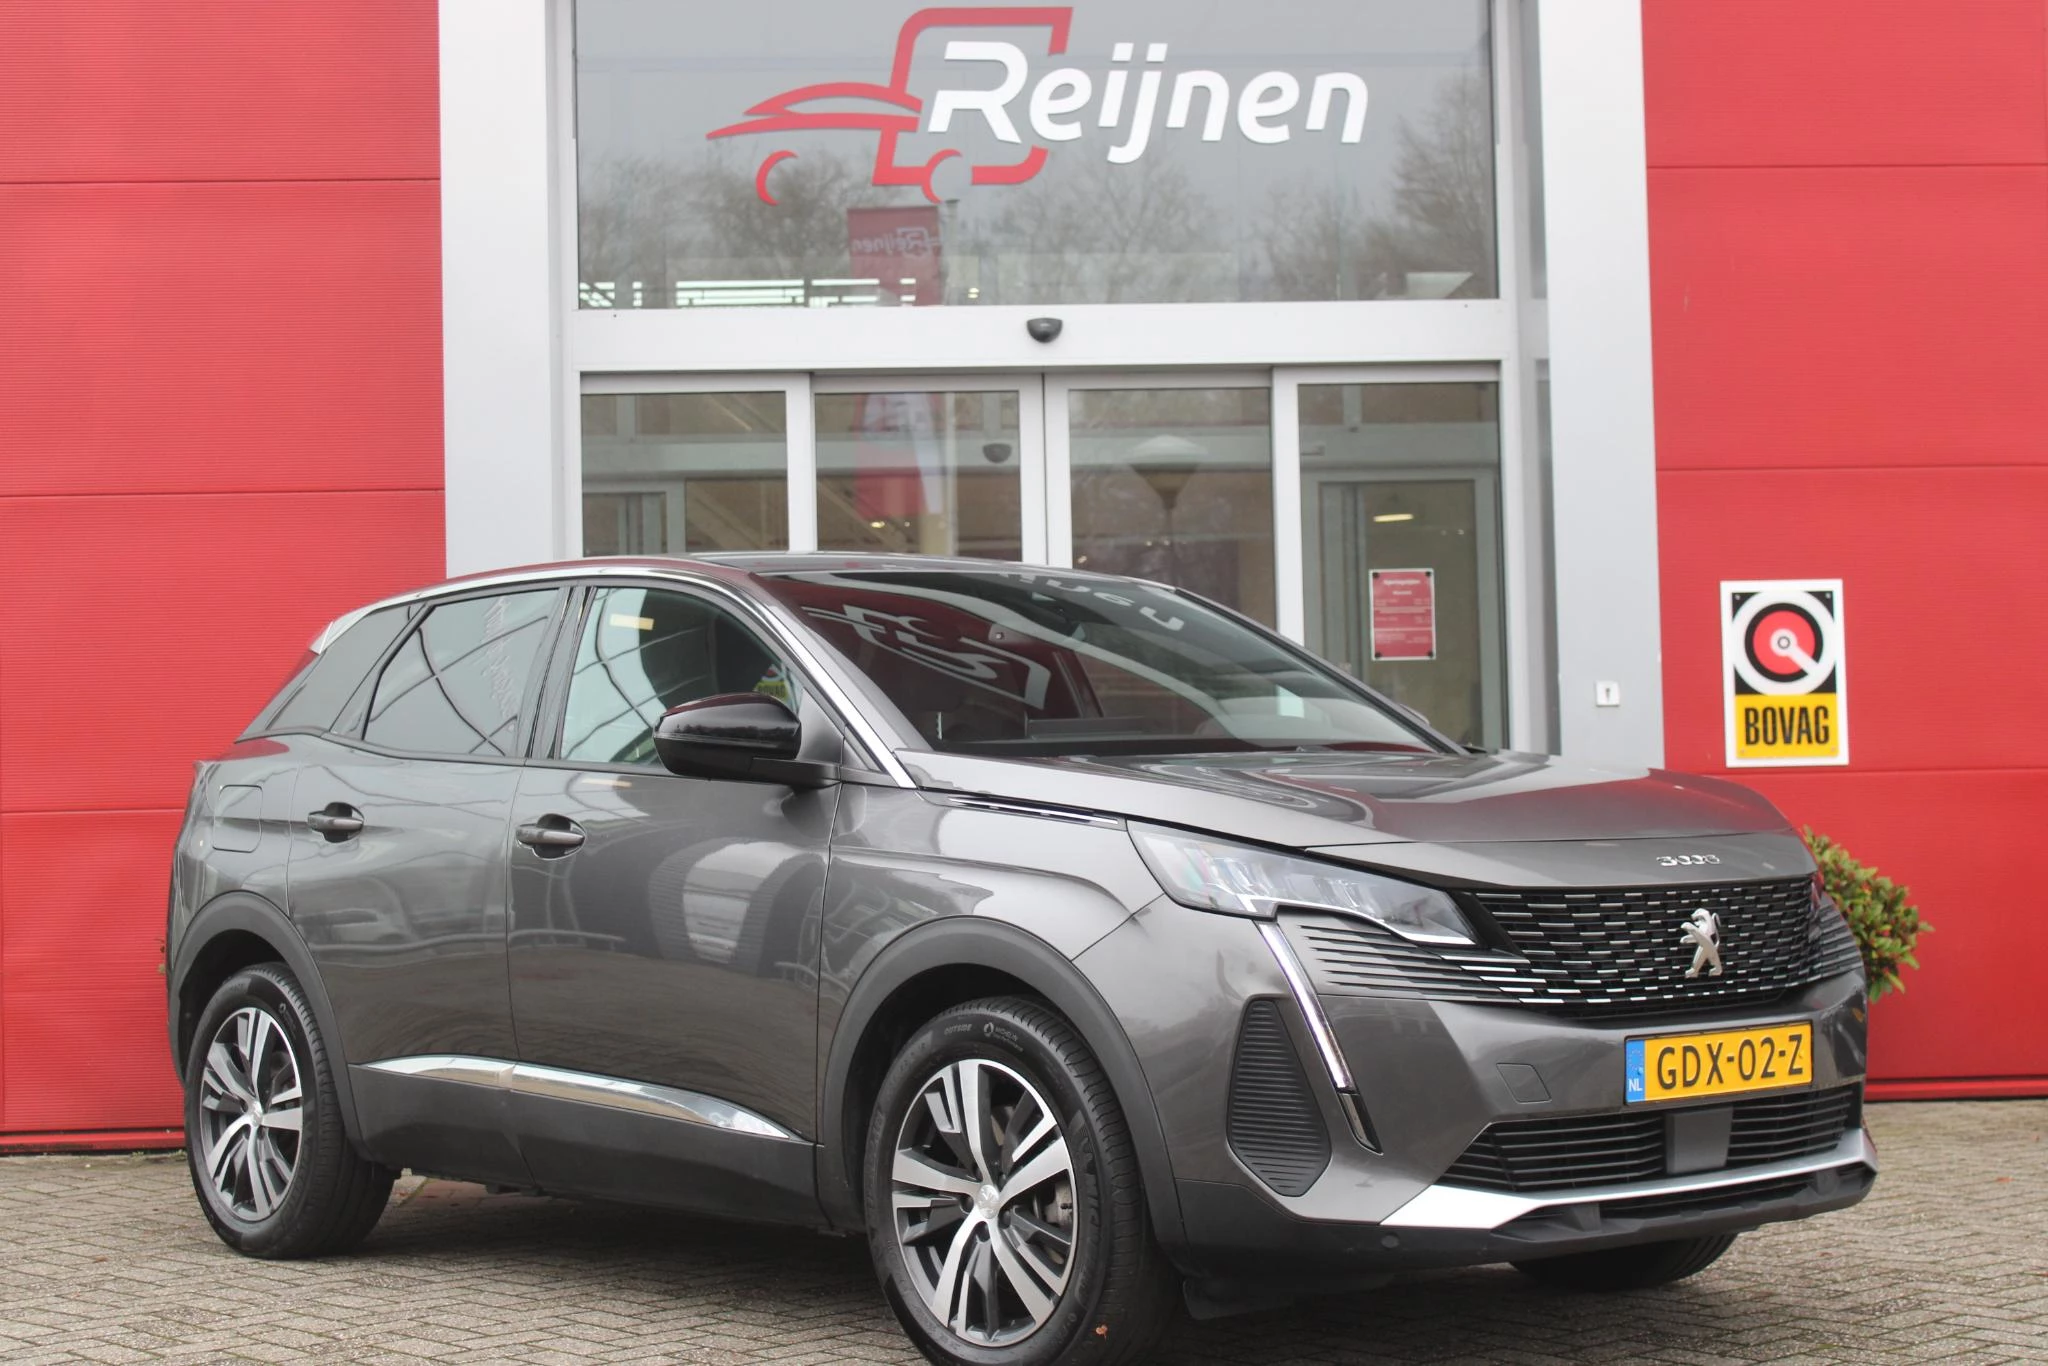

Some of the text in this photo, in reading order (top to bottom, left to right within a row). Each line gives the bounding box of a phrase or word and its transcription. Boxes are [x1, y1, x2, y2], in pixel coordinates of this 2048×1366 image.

[928, 40, 1369, 164] Reijnen
[1744, 705, 1830, 746] BOVAG
[1628, 1078, 1643, 1092] NL
[1657, 1034, 1803, 1090] GDX-02-Z
